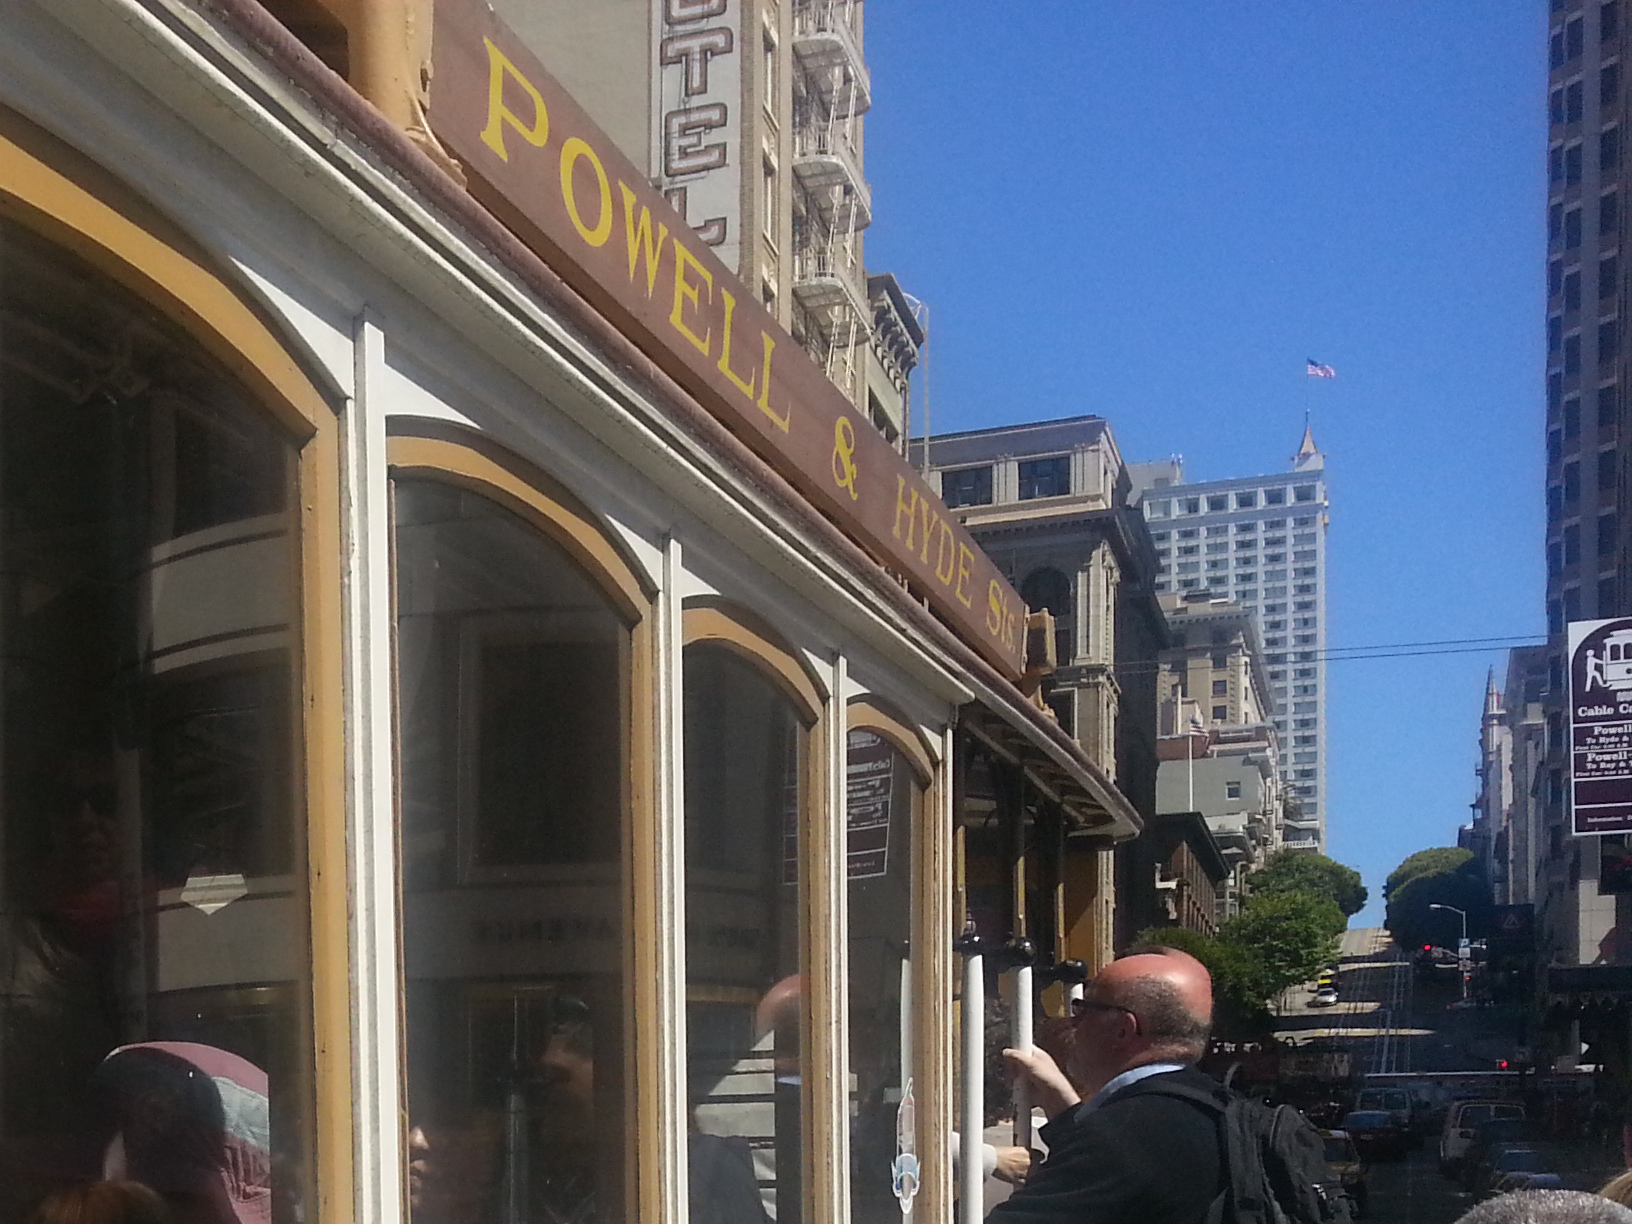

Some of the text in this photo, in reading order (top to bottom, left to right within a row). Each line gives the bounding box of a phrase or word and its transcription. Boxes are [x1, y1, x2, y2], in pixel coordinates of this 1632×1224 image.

[660, 0, 734, 247] TEL
[480, 35, 792, 434] POWELL
[831, 415, 858, 501] &
[892, 473, 976, 610] HYDE
[1578, 705, 1614, 717] Cable
